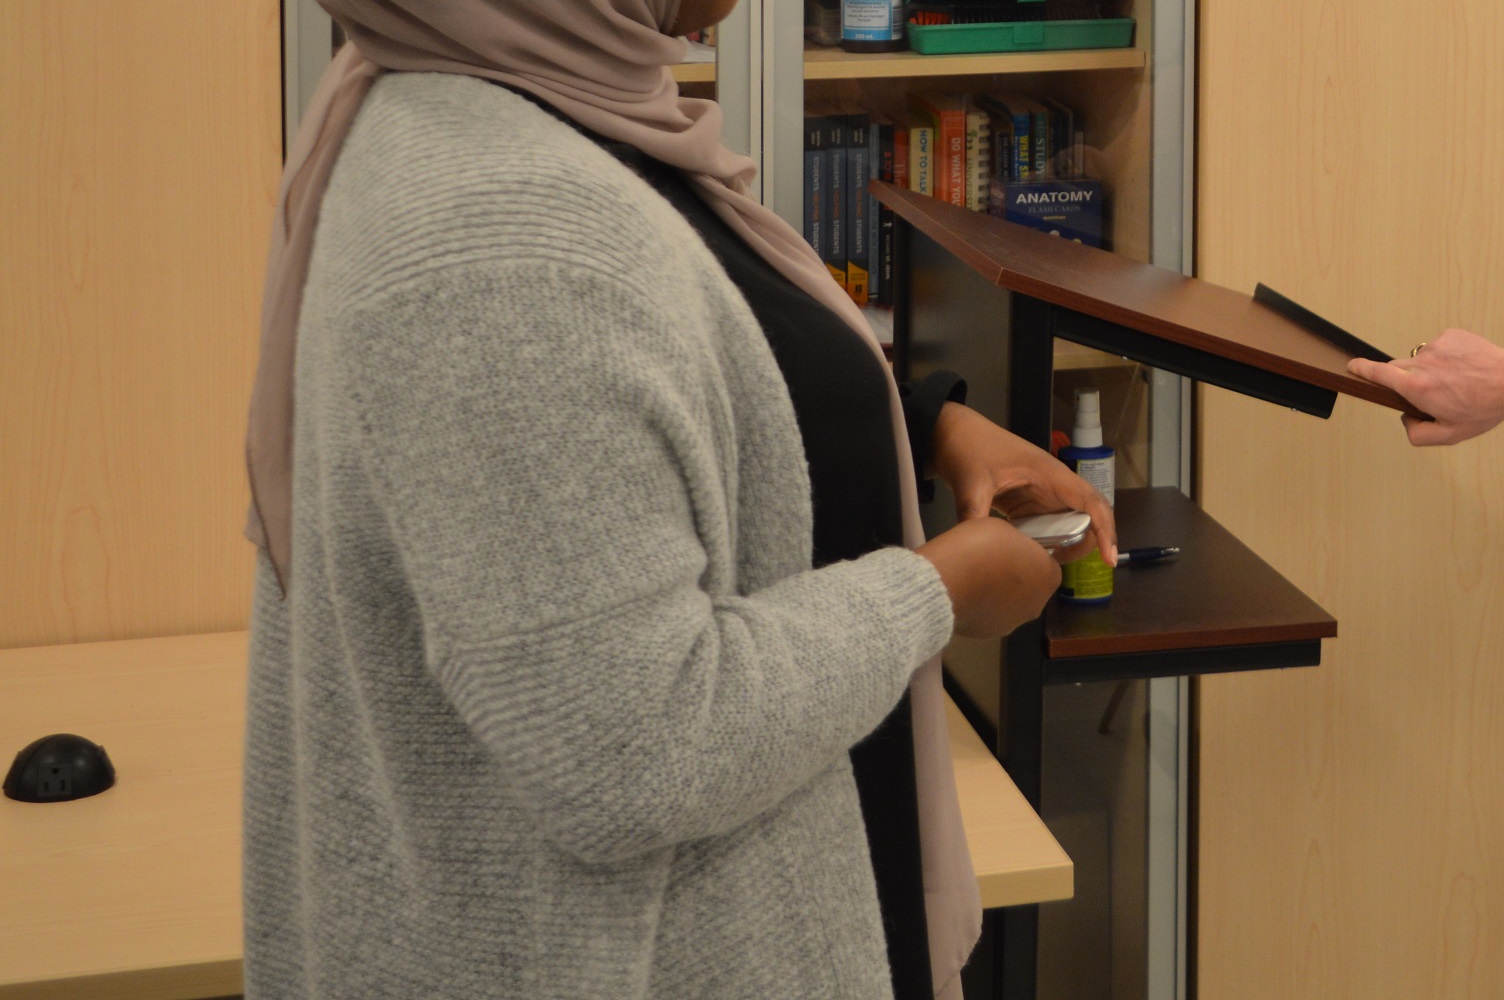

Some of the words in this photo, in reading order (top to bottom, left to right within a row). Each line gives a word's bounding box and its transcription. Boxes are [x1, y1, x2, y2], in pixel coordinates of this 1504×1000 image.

[919, 130, 929, 153] HOW
[952, 137, 961, 151] DO
[1019, 135, 1029, 162] WHAT
[919, 156, 928, 169] TO
[952, 153, 961, 184] WHAT
[1035, 137, 1046, 175] STUDY
[832, 154, 840, 189] STUDENTS
[855, 153, 863, 188] STUDENTS
[919, 170, 928, 193] TALK
[952, 185, 961, 206] YOU
[1015, 190, 1093, 205] ANATOMY
[1028, 206, 1055, 214] FLASH
[832, 219, 840, 254] STUDENTS
[855, 218, 863, 254] STUDENTS
